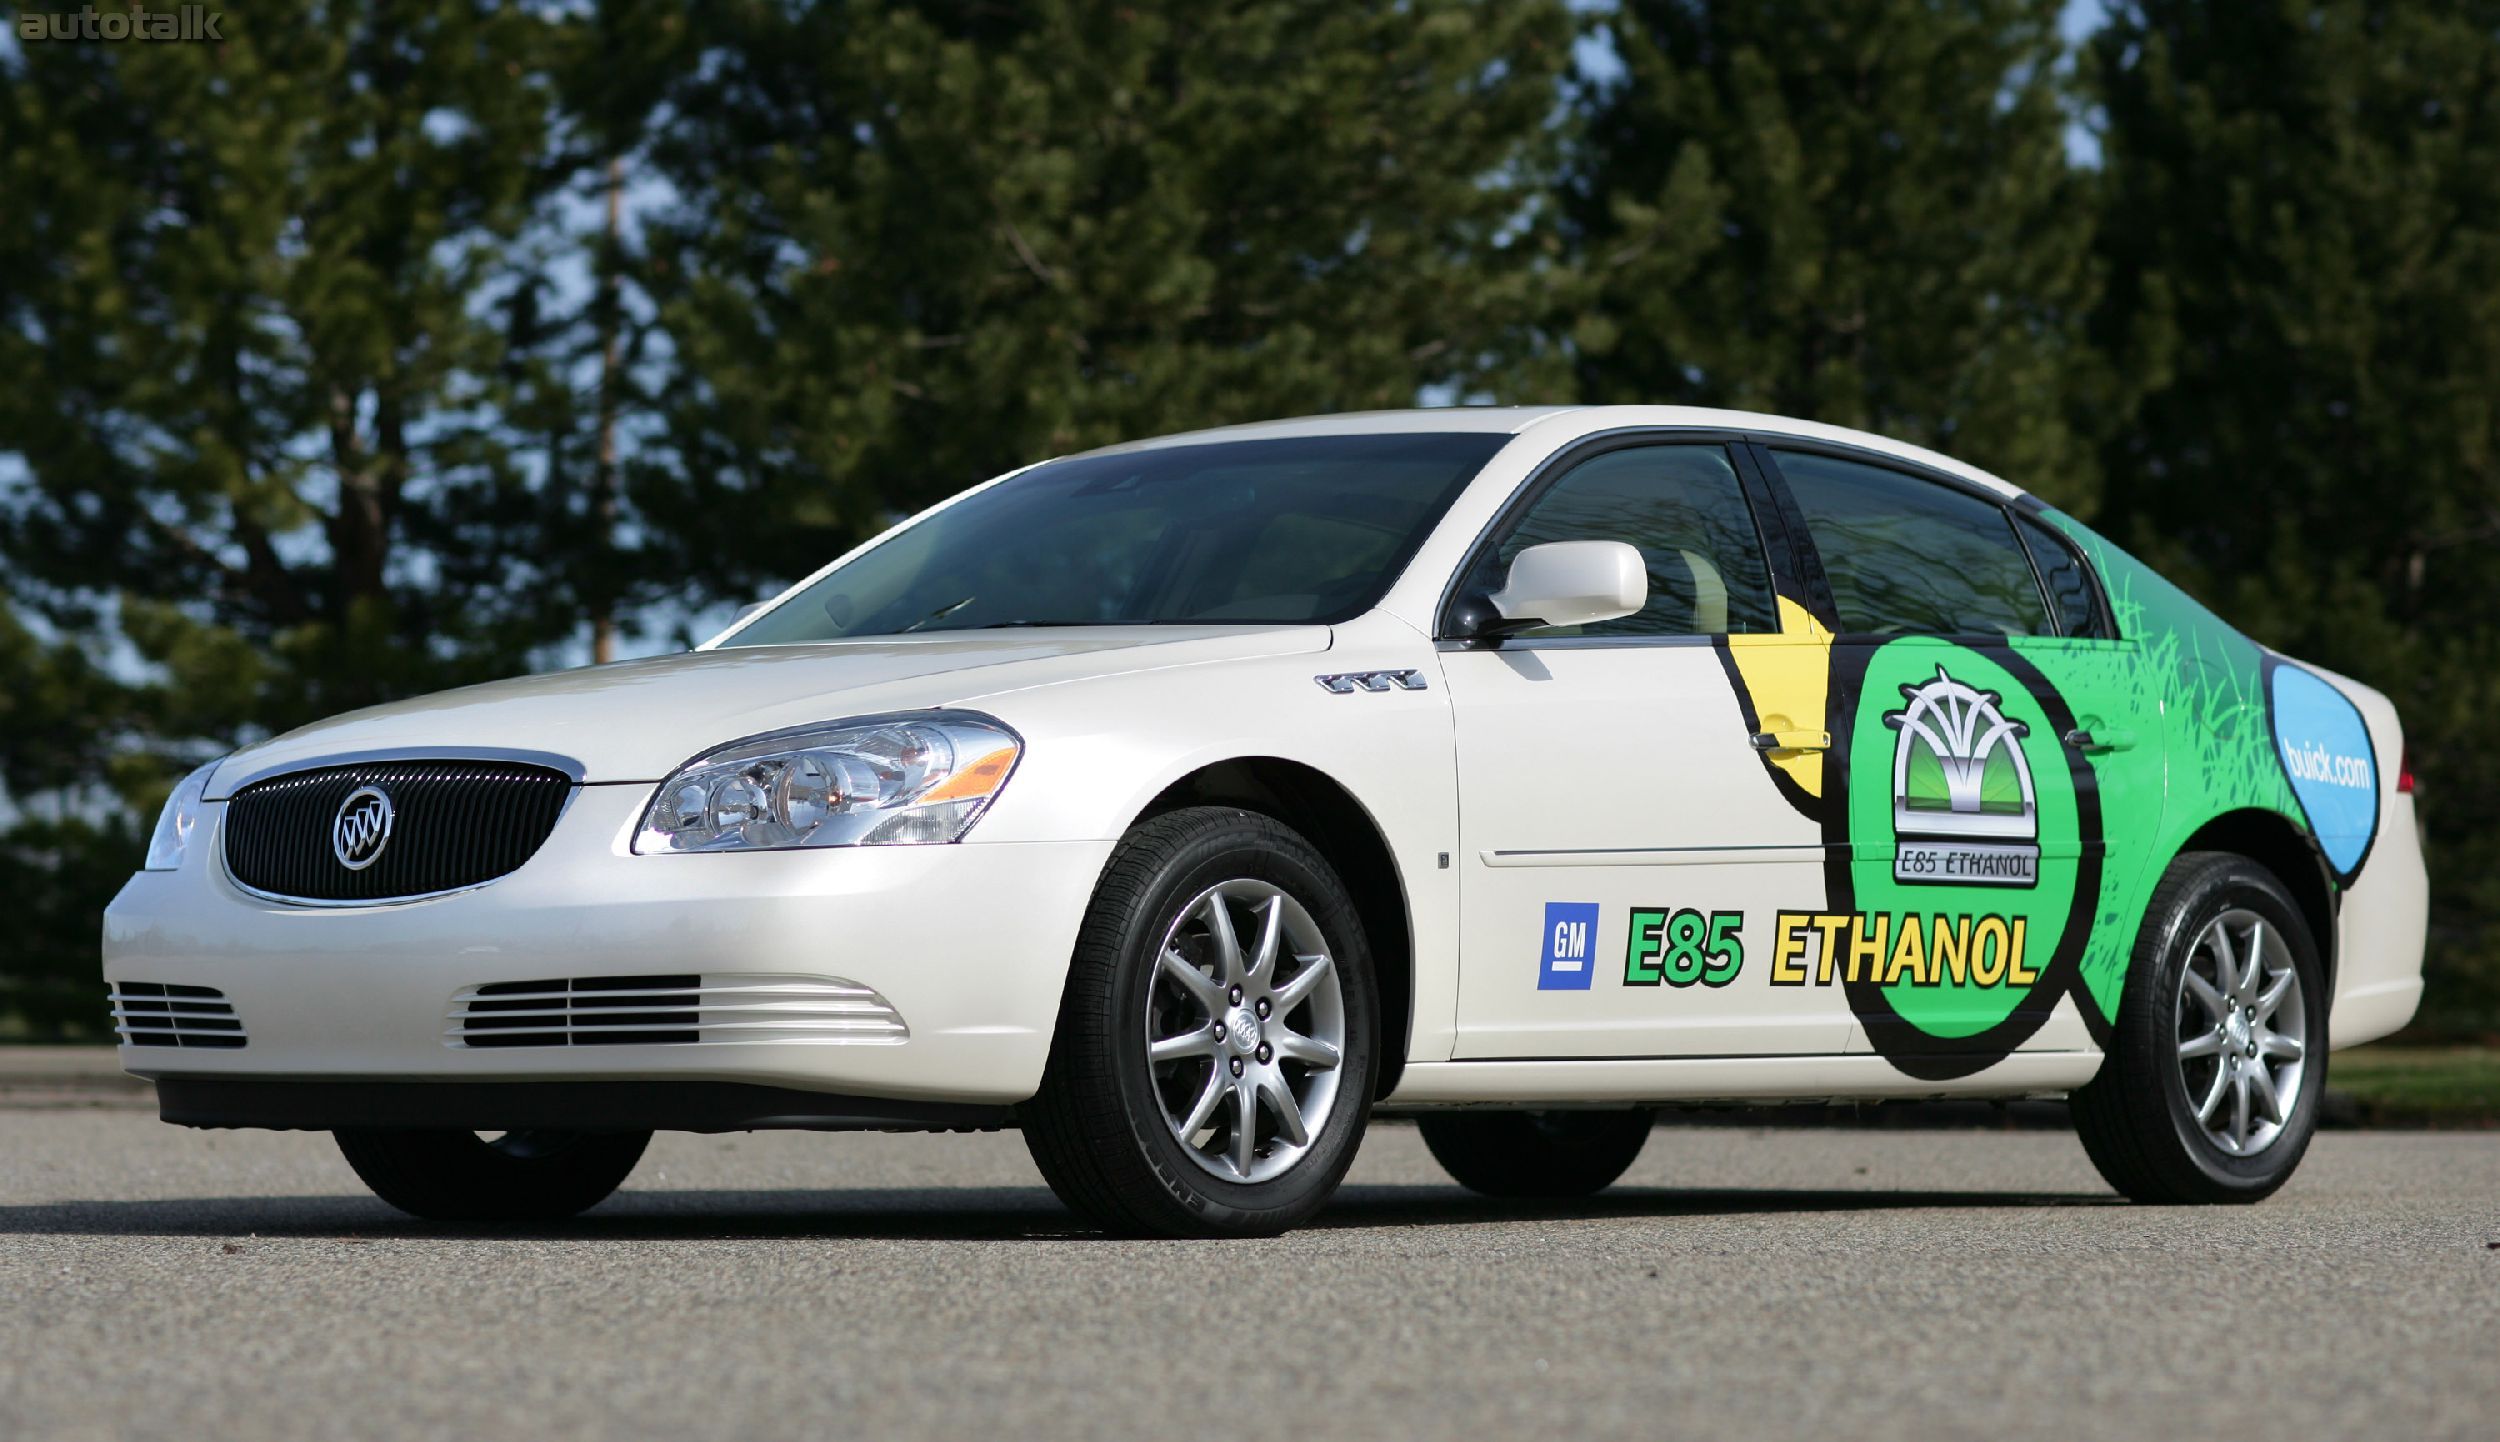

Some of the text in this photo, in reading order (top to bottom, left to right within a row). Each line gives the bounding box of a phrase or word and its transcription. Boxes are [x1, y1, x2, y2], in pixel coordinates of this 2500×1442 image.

[2284, 737, 2370, 790] buick.com
[1901, 850, 2031, 877] E85 ETHANOL
[1554, 920, 1586, 958] GM
[1624, 907, 2040, 989] E85 ETHANOL
